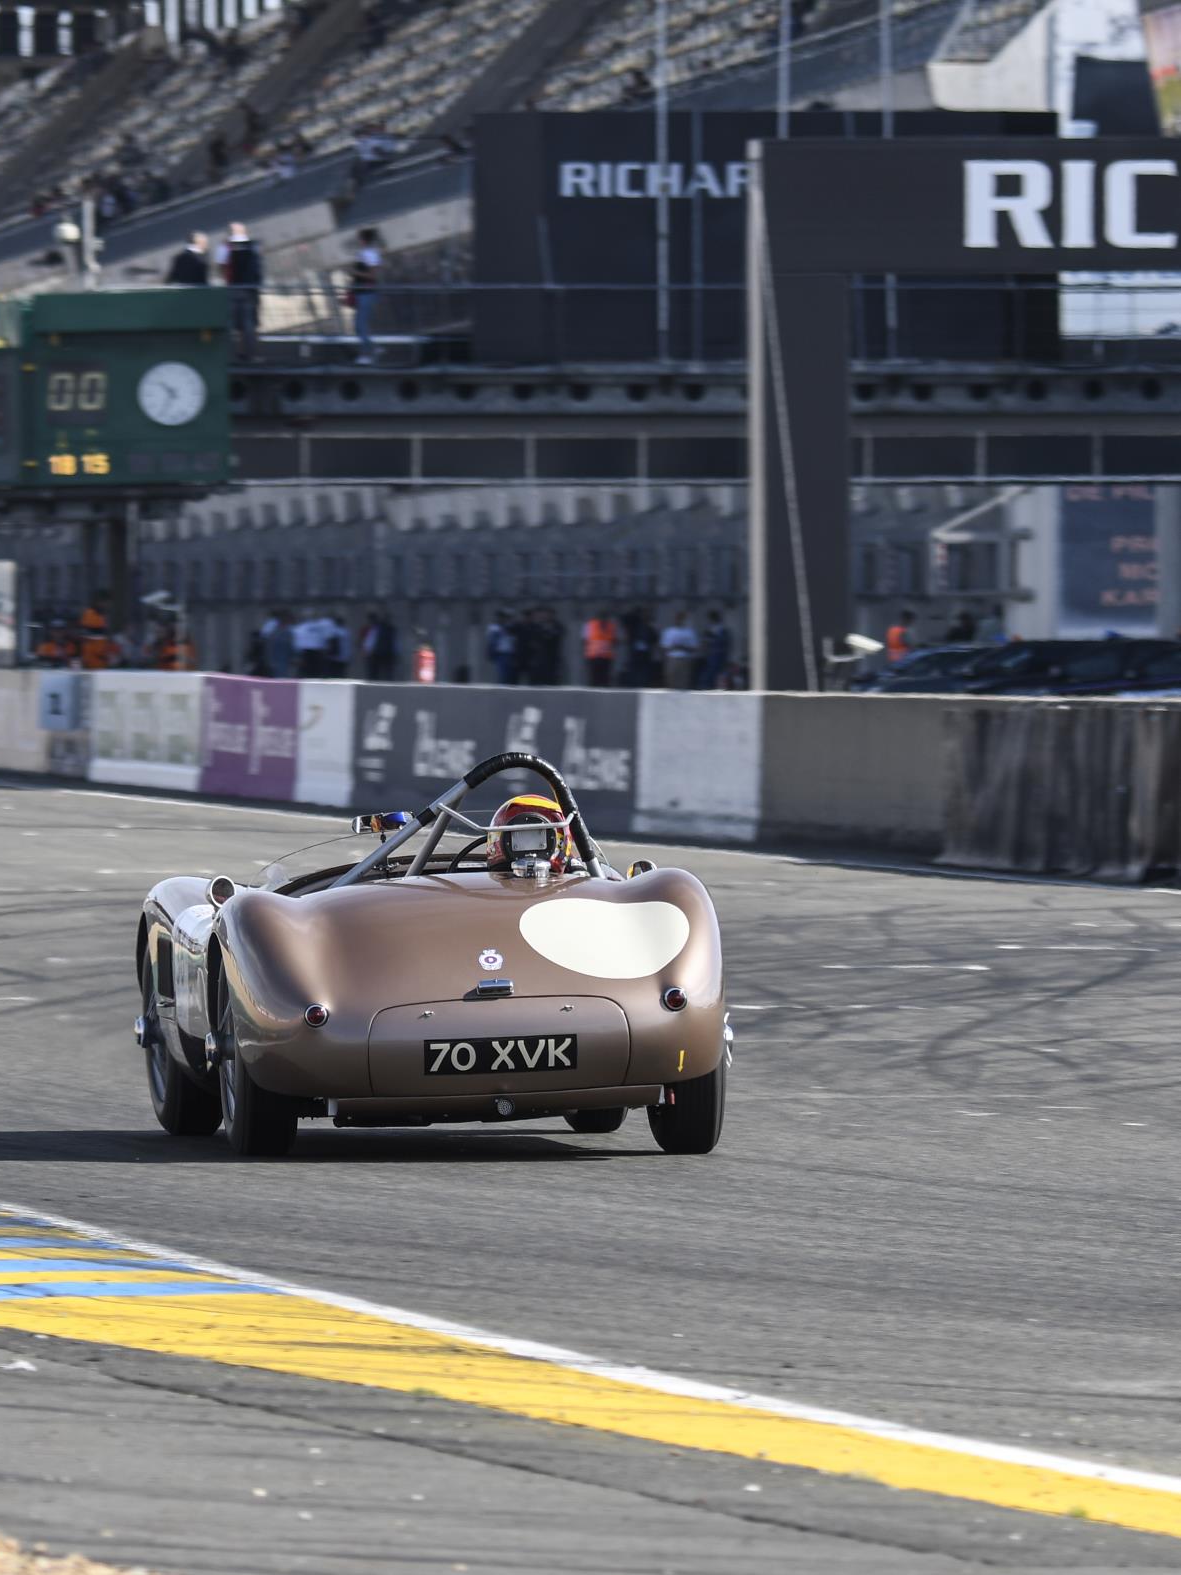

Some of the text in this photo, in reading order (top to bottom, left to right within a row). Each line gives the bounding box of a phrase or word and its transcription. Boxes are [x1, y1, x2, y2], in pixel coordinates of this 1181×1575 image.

[963, 159, 1178, 249] RIC
[429, 1037, 572, 1073] 70 XVK
